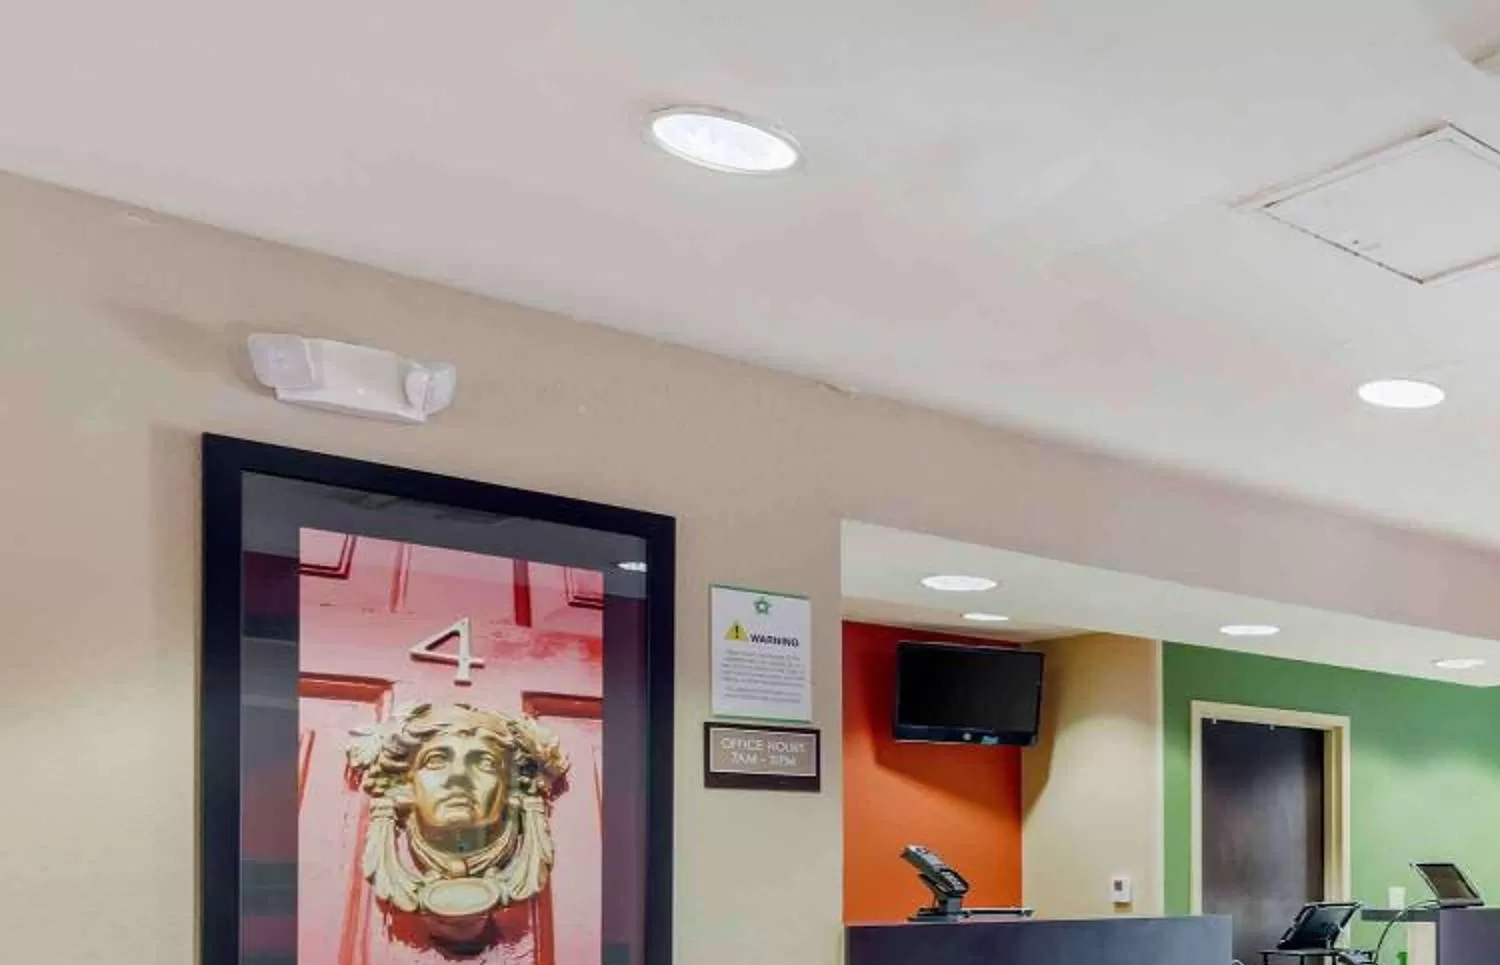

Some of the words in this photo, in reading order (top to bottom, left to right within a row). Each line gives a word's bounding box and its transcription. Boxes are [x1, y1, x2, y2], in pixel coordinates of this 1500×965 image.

[750, 633, 800, 647] WARNING
[408, 616, 485, 686] 4
[720, 737, 764, 751] OFFICE
